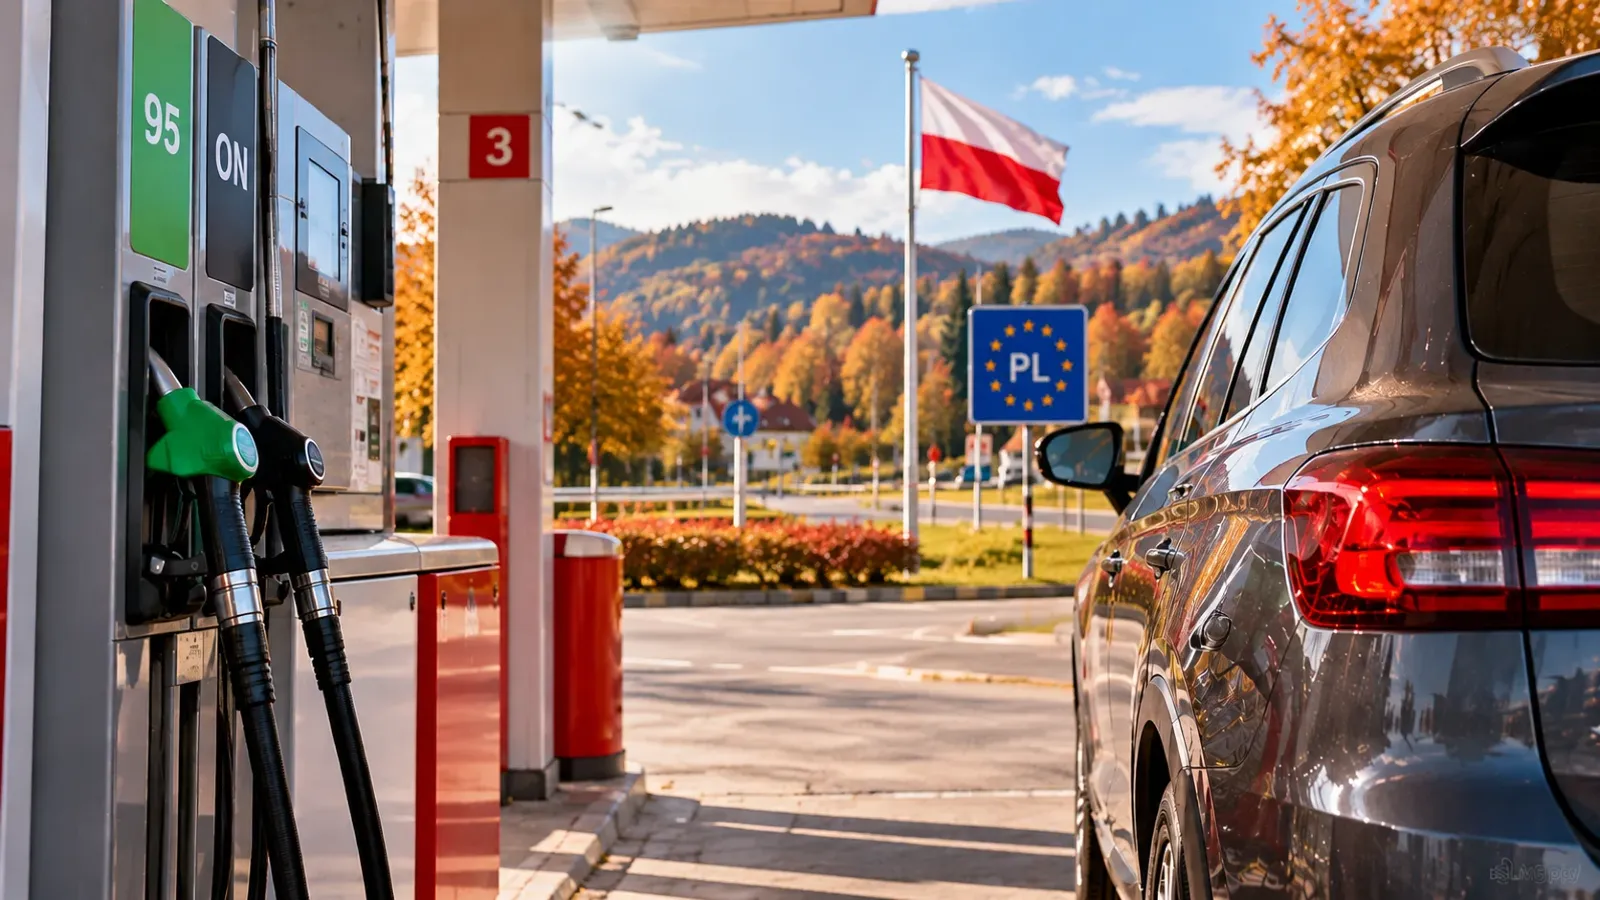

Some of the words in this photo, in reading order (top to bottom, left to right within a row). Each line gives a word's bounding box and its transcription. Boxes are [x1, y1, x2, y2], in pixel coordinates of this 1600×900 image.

[144, 93, 180, 155] 95
[486, 127, 513, 166] 3
[215, 132, 248, 191] ON
[1010, 352, 1051, 383] PL
